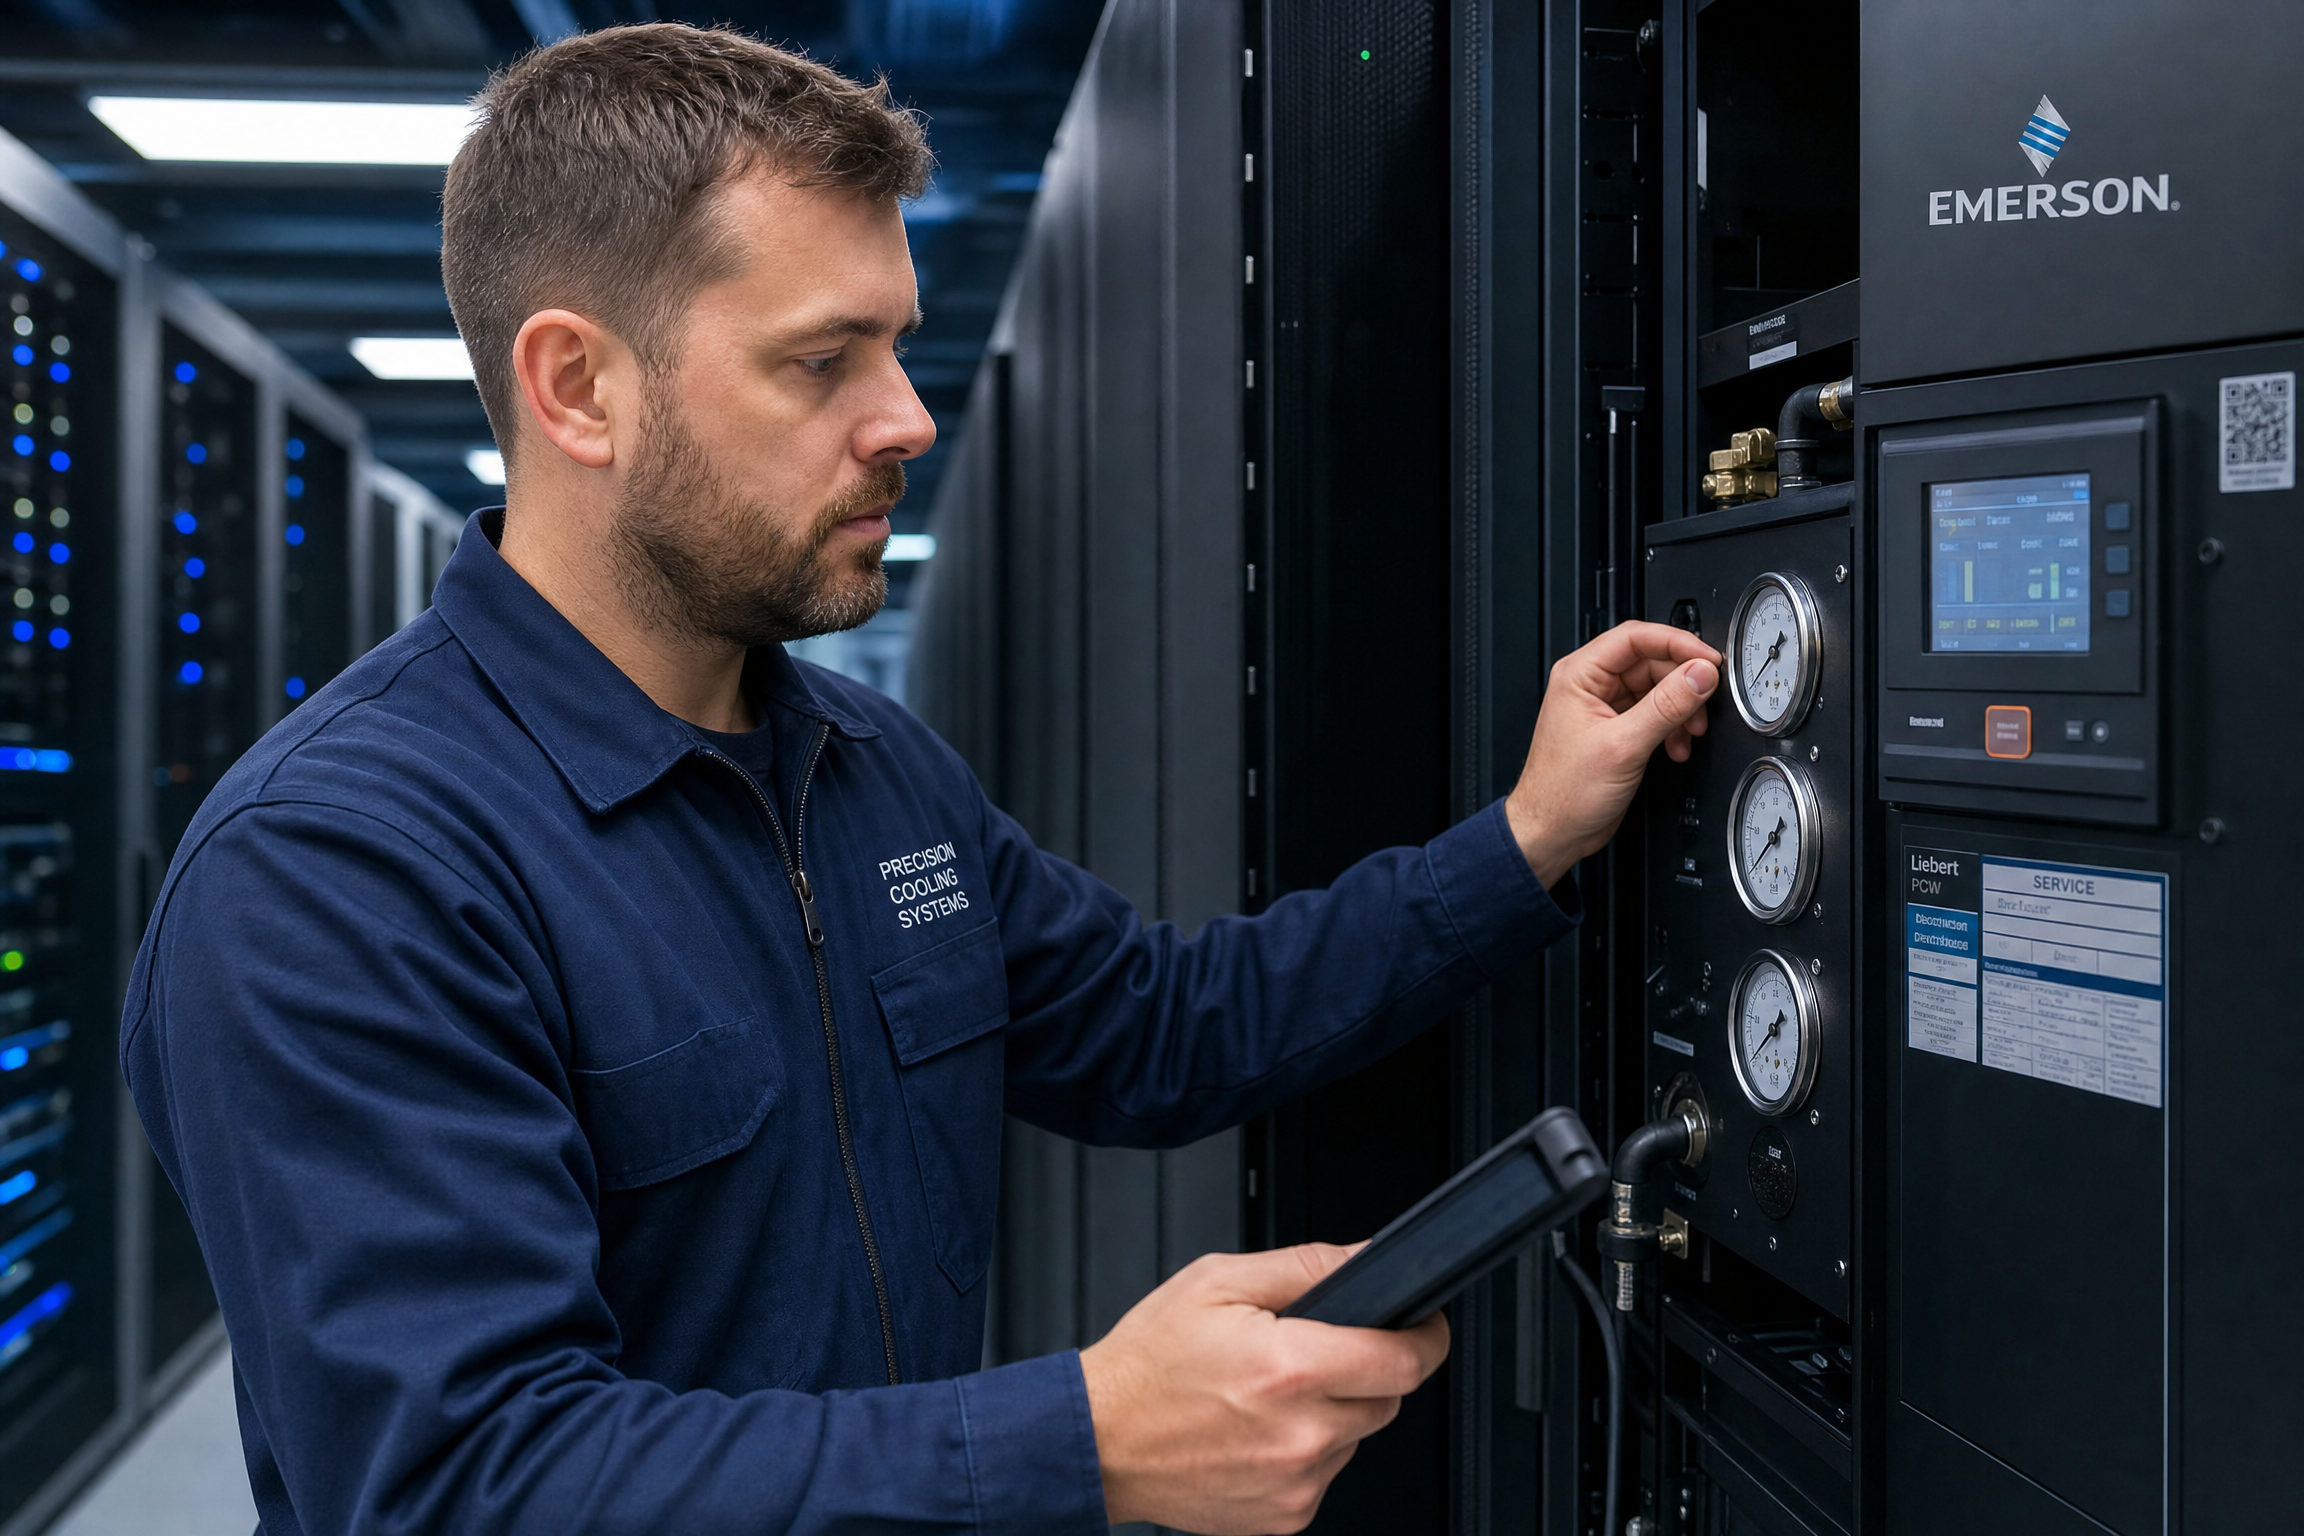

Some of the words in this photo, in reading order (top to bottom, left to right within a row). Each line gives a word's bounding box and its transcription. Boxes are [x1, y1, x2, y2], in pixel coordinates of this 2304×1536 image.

[1929, 174, 2169, 226] EMERSON
[879, 841, 957, 881] PRECISION
[1911, 854, 1960, 876] Liebert
[890, 867, 958, 904] COOLING
[1911, 878, 1942, 895] PCW
[2033, 875, 2095, 895] SERVICE
[898, 890, 969, 928] SYSTEMS
